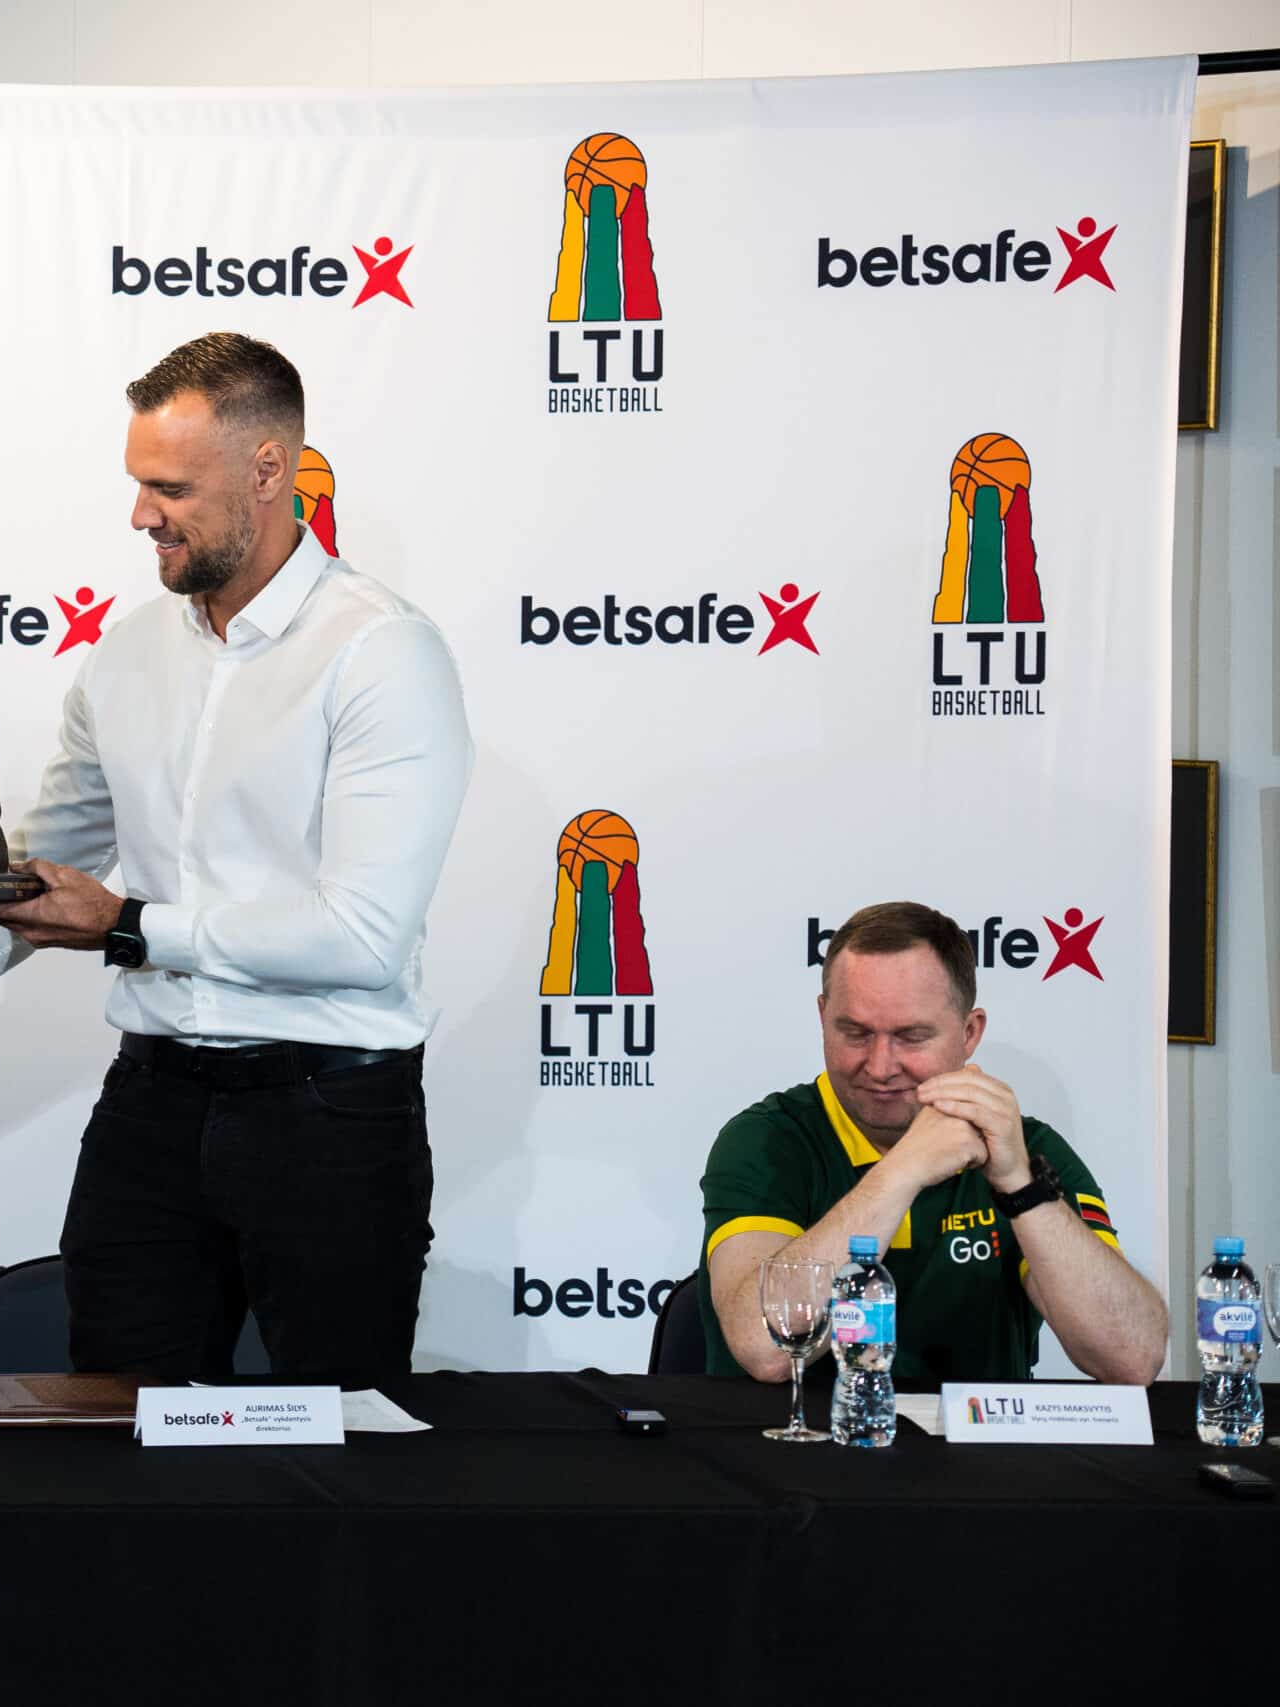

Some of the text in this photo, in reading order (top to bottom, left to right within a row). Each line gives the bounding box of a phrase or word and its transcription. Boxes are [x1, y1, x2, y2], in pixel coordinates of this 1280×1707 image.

[112, 246, 348, 297] betsafe
[817, 230, 1052, 289] betsafe
[548, 329, 663, 383] LTU
[548, 387, 663, 414] BASKETBALL
[520, 593, 755, 645] betsafe
[932, 631, 1046, 686] LTU
[932, 690, 1046, 716] BASKETBALL
[540, 1003, 655, 1056] LTU
[540, 1061, 655, 1087] BASKETBALL
[164, 1413, 220, 1426] betsafe
[245, 1404, 285, 1413] AURIMAS
[984, 1397, 1024, 1415] LTU
